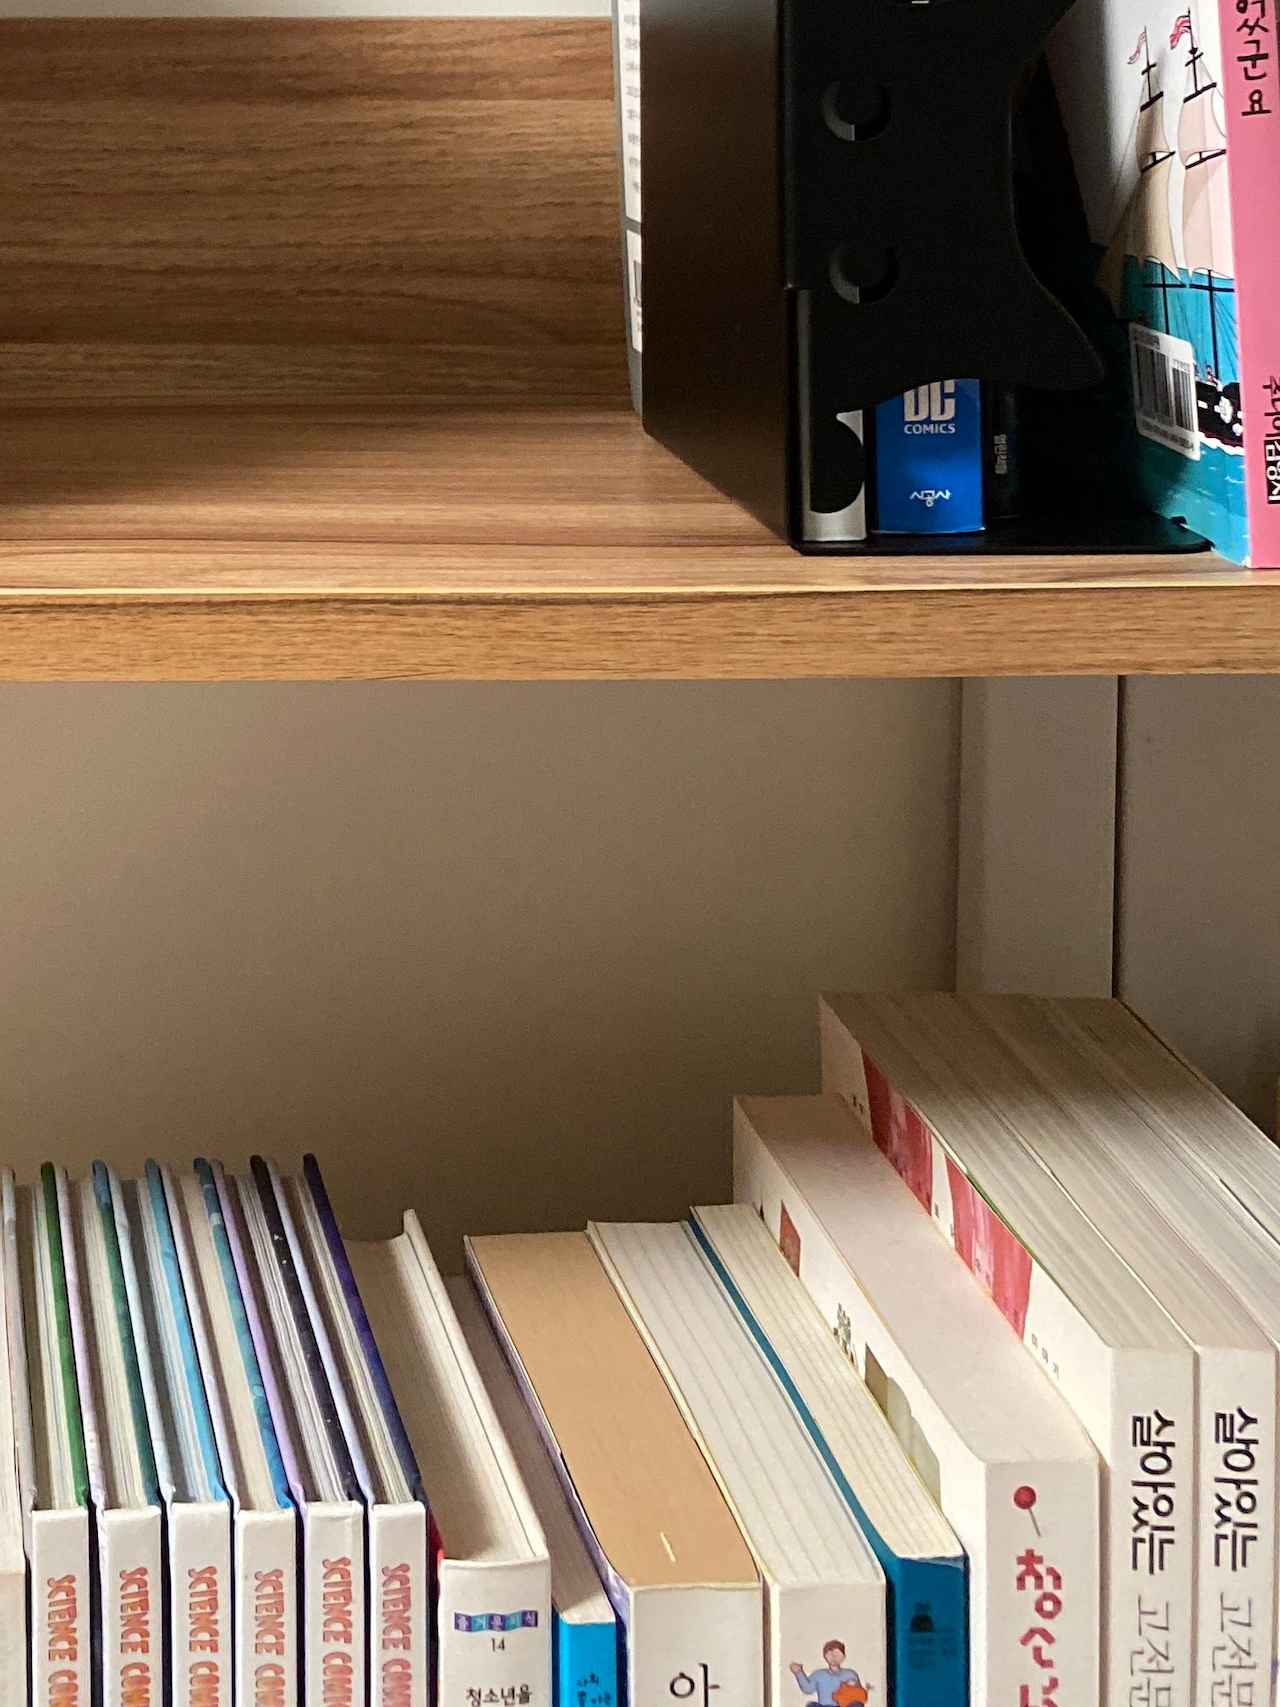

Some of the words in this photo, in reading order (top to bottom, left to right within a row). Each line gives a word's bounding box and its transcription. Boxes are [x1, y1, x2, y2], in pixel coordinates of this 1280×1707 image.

[903, 422, 956, 435] COMICS
[908, 489, 951, 508] 시공사
[1130, 1408, 1176, 1576] 살아있는
[1213, 1405, 1259, 1573] 살아있는
[47, 1573, 79, 1663] SCIENCE
[120, 1566, 151, 1654] SCIENCE
[187, 1565, 220, 1654] SCIENCE
[254, 1568, 285, 1656] SCIENCE
[322, 1556, 354, 1645] SCIENCE
[381, 1562, 412, 1651] SCIENCE
[322, 1651, 354, 1707] COMI
[490, 1637, 507, 1653] 14
[465, 1683, 534, 1707] 청소년을
